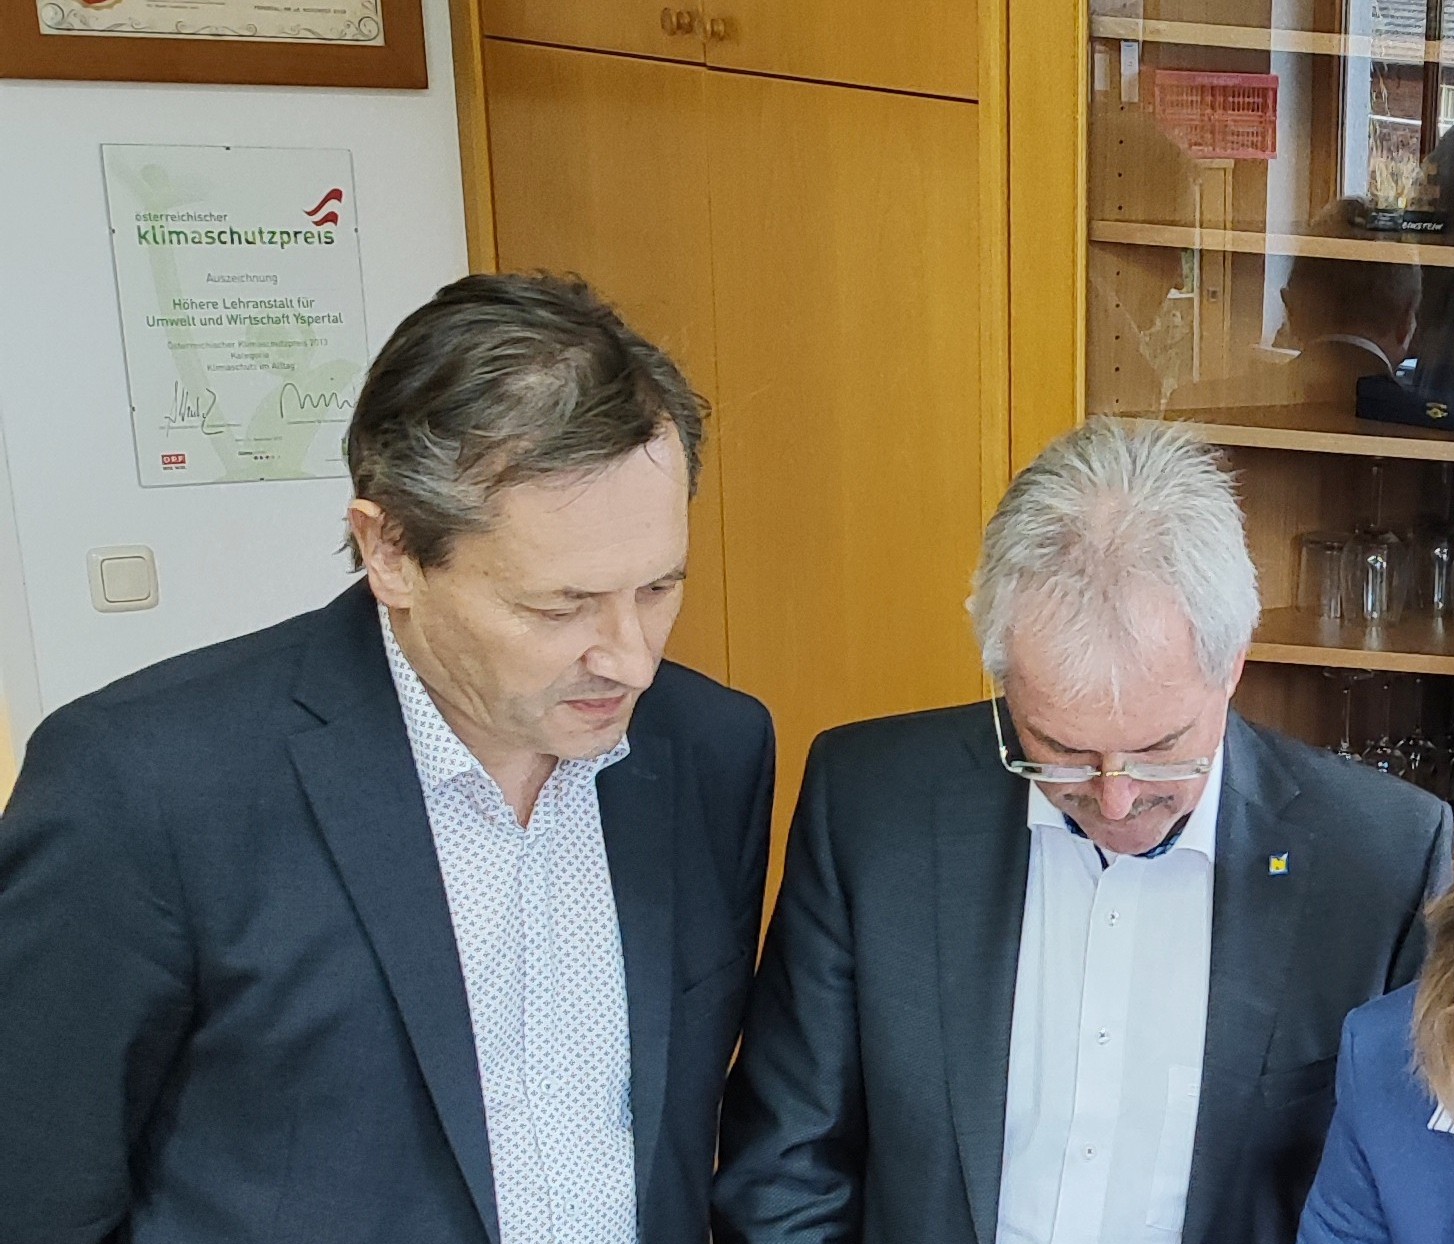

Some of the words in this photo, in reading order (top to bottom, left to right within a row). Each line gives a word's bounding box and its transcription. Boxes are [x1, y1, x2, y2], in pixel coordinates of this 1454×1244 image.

[136, 224, 335, 249] klimaschutzpreis
[206, 273, 278, 285] Auszeichnung
[172, 298, 219, 310] Höhere
[222, 297, 294, 309] Lehranstalt
[297, 296, 315, 308] für
[146, 314, 197, 327] Umwelt
[200, 314, 223, 326] und
[226, 313, 290, 326] Wirtschaft
[293, 312, 344, 327] Yspertal
